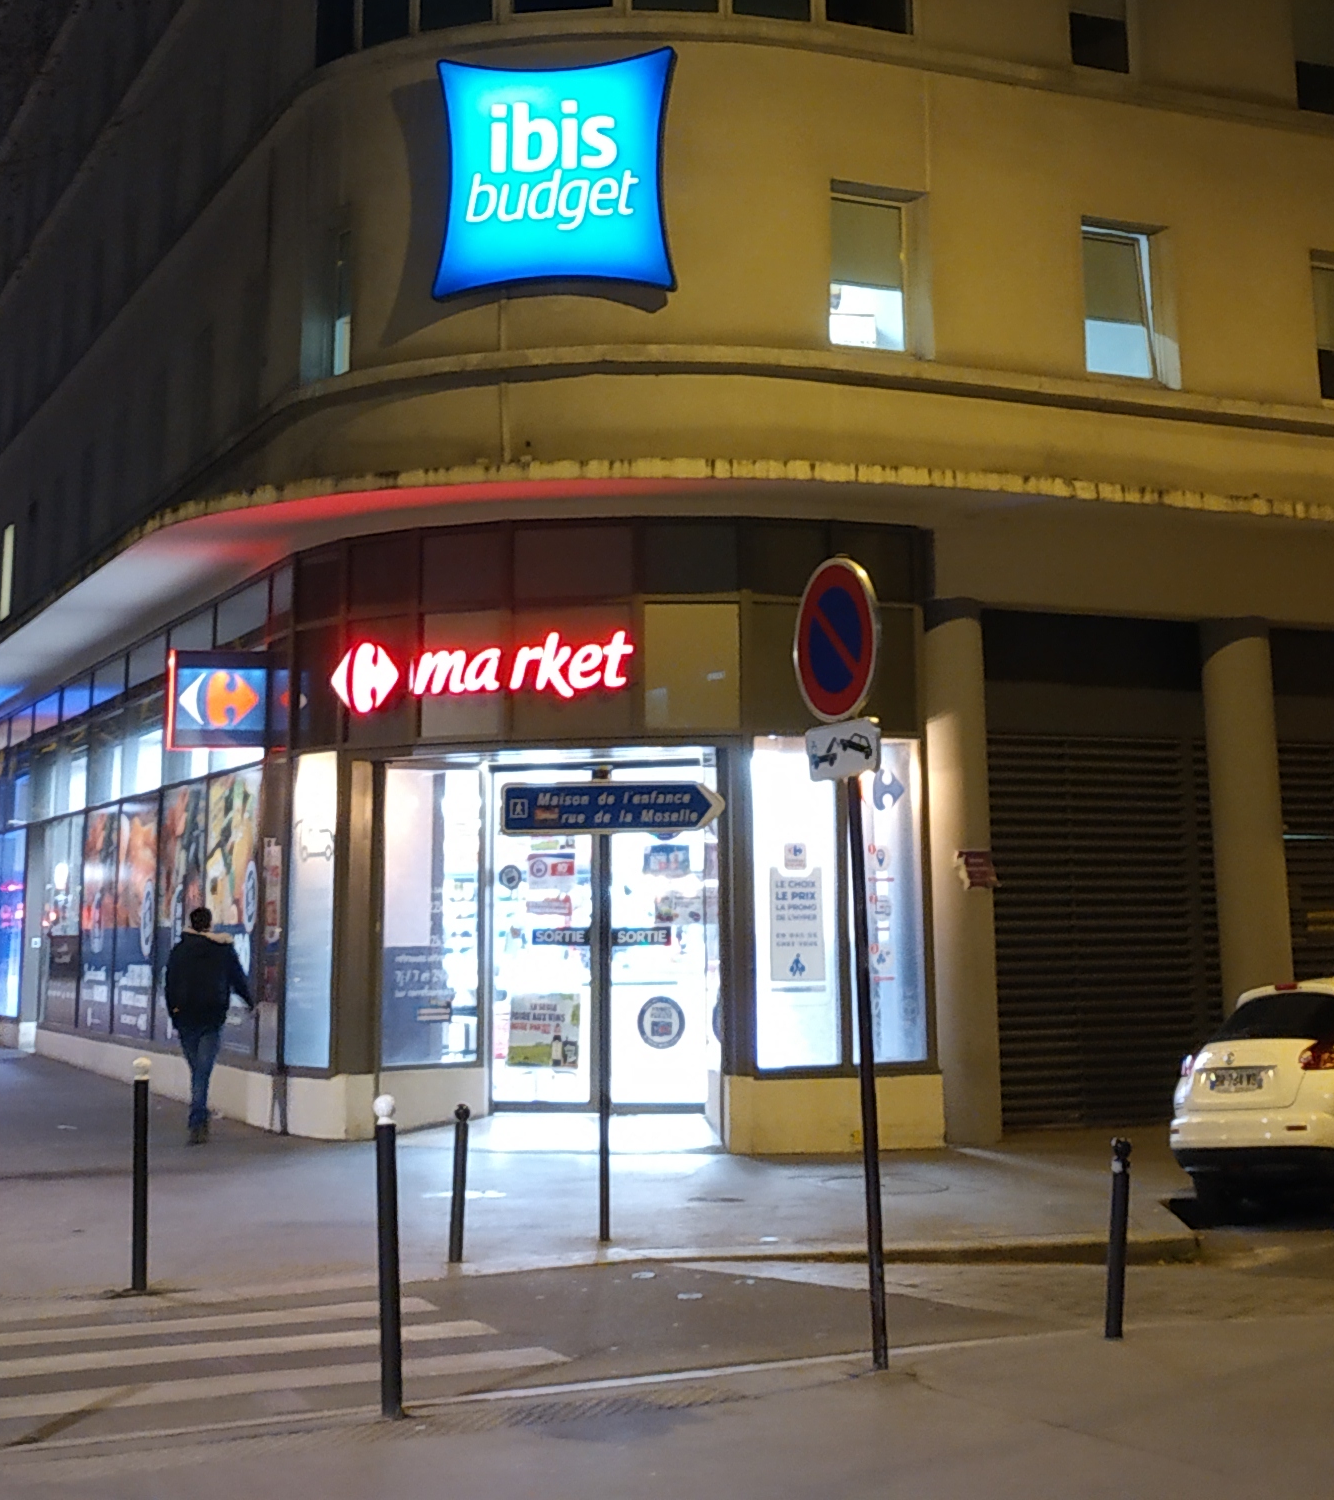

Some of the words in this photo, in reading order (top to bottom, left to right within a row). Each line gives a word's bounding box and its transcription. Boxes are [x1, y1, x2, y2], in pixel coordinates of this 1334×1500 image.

[490, 99, 617, 173] ibis
[466, 168, 639, 231] budget
[413, 630, 633, 698] market
[536, 792, 590, 806] Maison
[597, 792, 615, 805] de
[622, 790, 691, 805] l'enfance
[561, 812, 586, 824] rue
[594, 810, 612, 823] de
[619, 809, 633, 823] la
[640, 808, 699, 823] Moselle
[791, 891, 816, 901] PRIX
[535, 930, 585, 943] SORTIE
[617, 930, 668, 943] SORTIE
